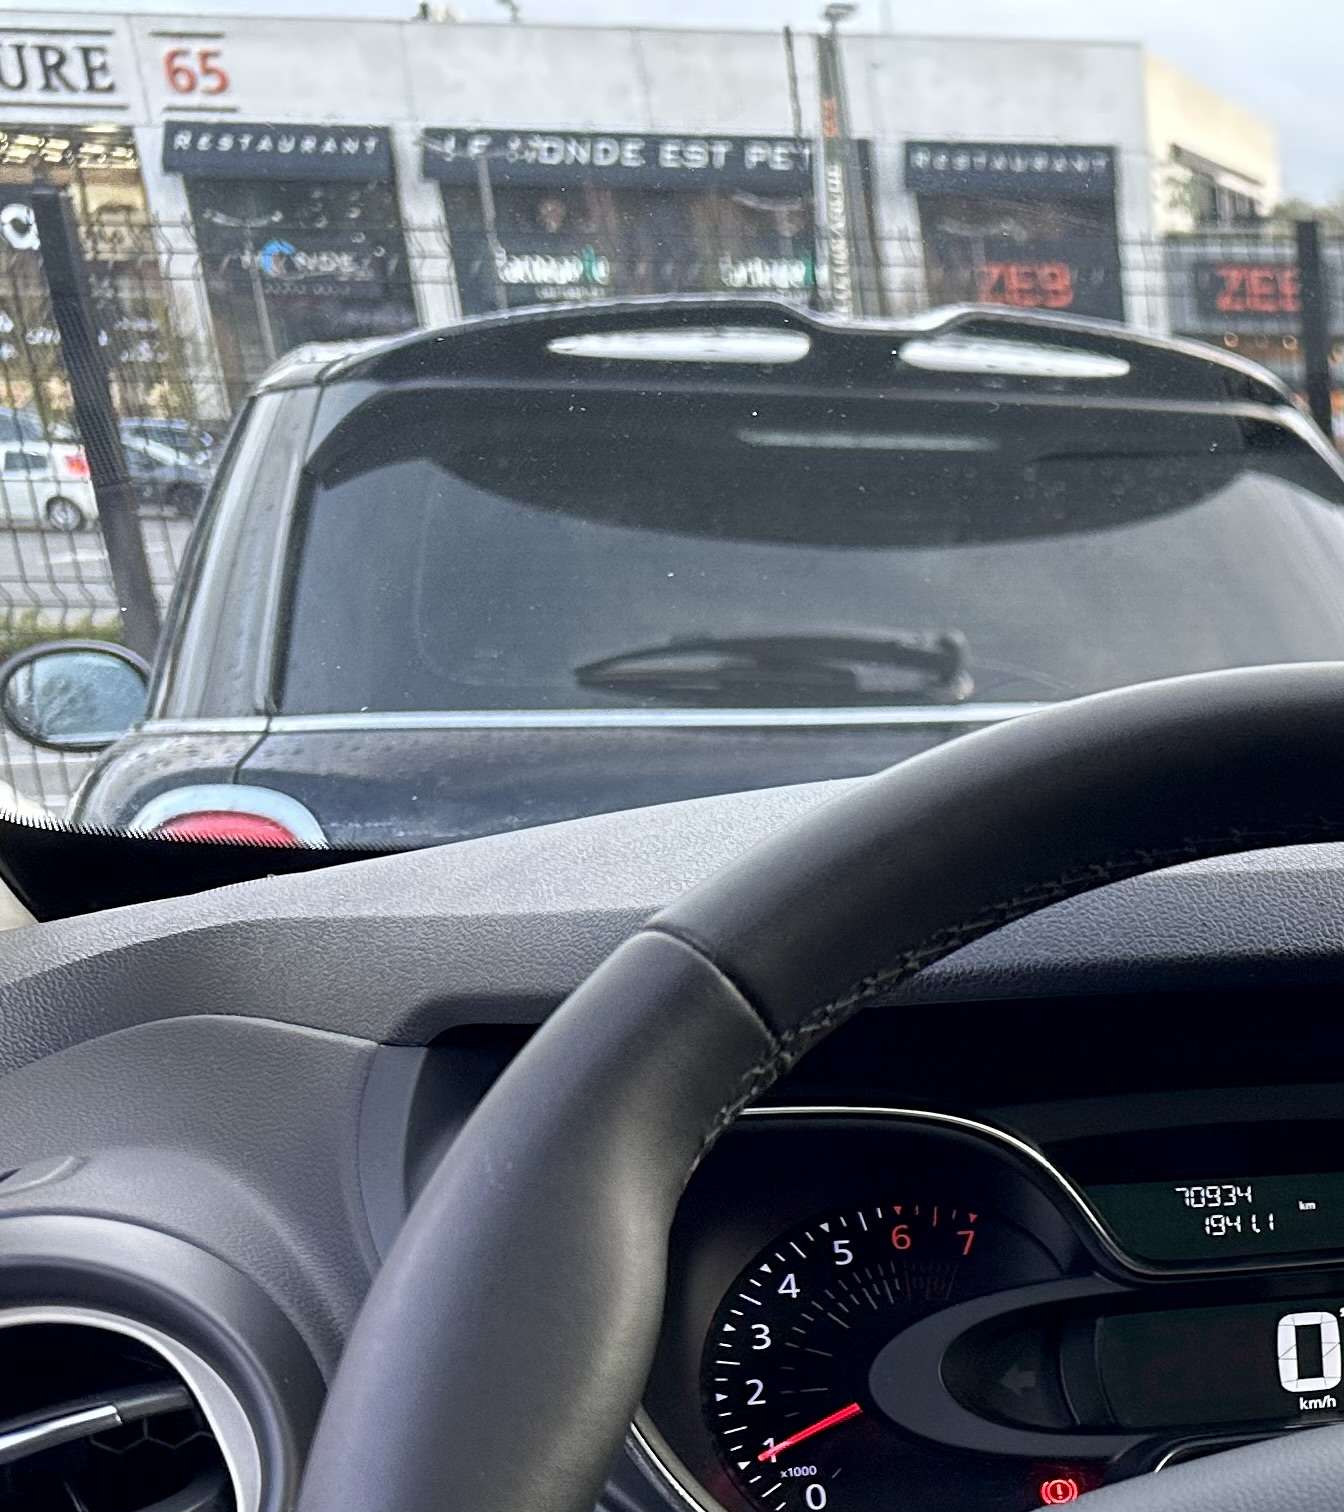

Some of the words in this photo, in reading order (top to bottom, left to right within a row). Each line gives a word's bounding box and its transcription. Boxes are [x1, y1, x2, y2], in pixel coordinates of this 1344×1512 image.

[163, 48, 230, 95] 65
[172, 130, 380, 156] RESTAURANT
[508, 135, 646, 168] ONDE
[658, 140, 733, 169] EST
[980, 262, 1073, 308] ZEB
[1174, 1184, 1252, 1209] 70934
[1298, 1200, 1316, 1211] km
[890, 1224, 912, 1250] 6
[957, 1230, 975, 1255] 7
[833, 1239, 854, 1266] 5
[777, 1273, 800, 1299] 4
[750, 1323, 772, 1350] 3
[1277, 1311, 1342, 1393] 0
[745, 1379, 766, 1406] 2
[1299, 1395, 1337, 1411] km/h
[780, 1465, 817, 1479] x1000
[805, 1483, 827, 1511] 0
